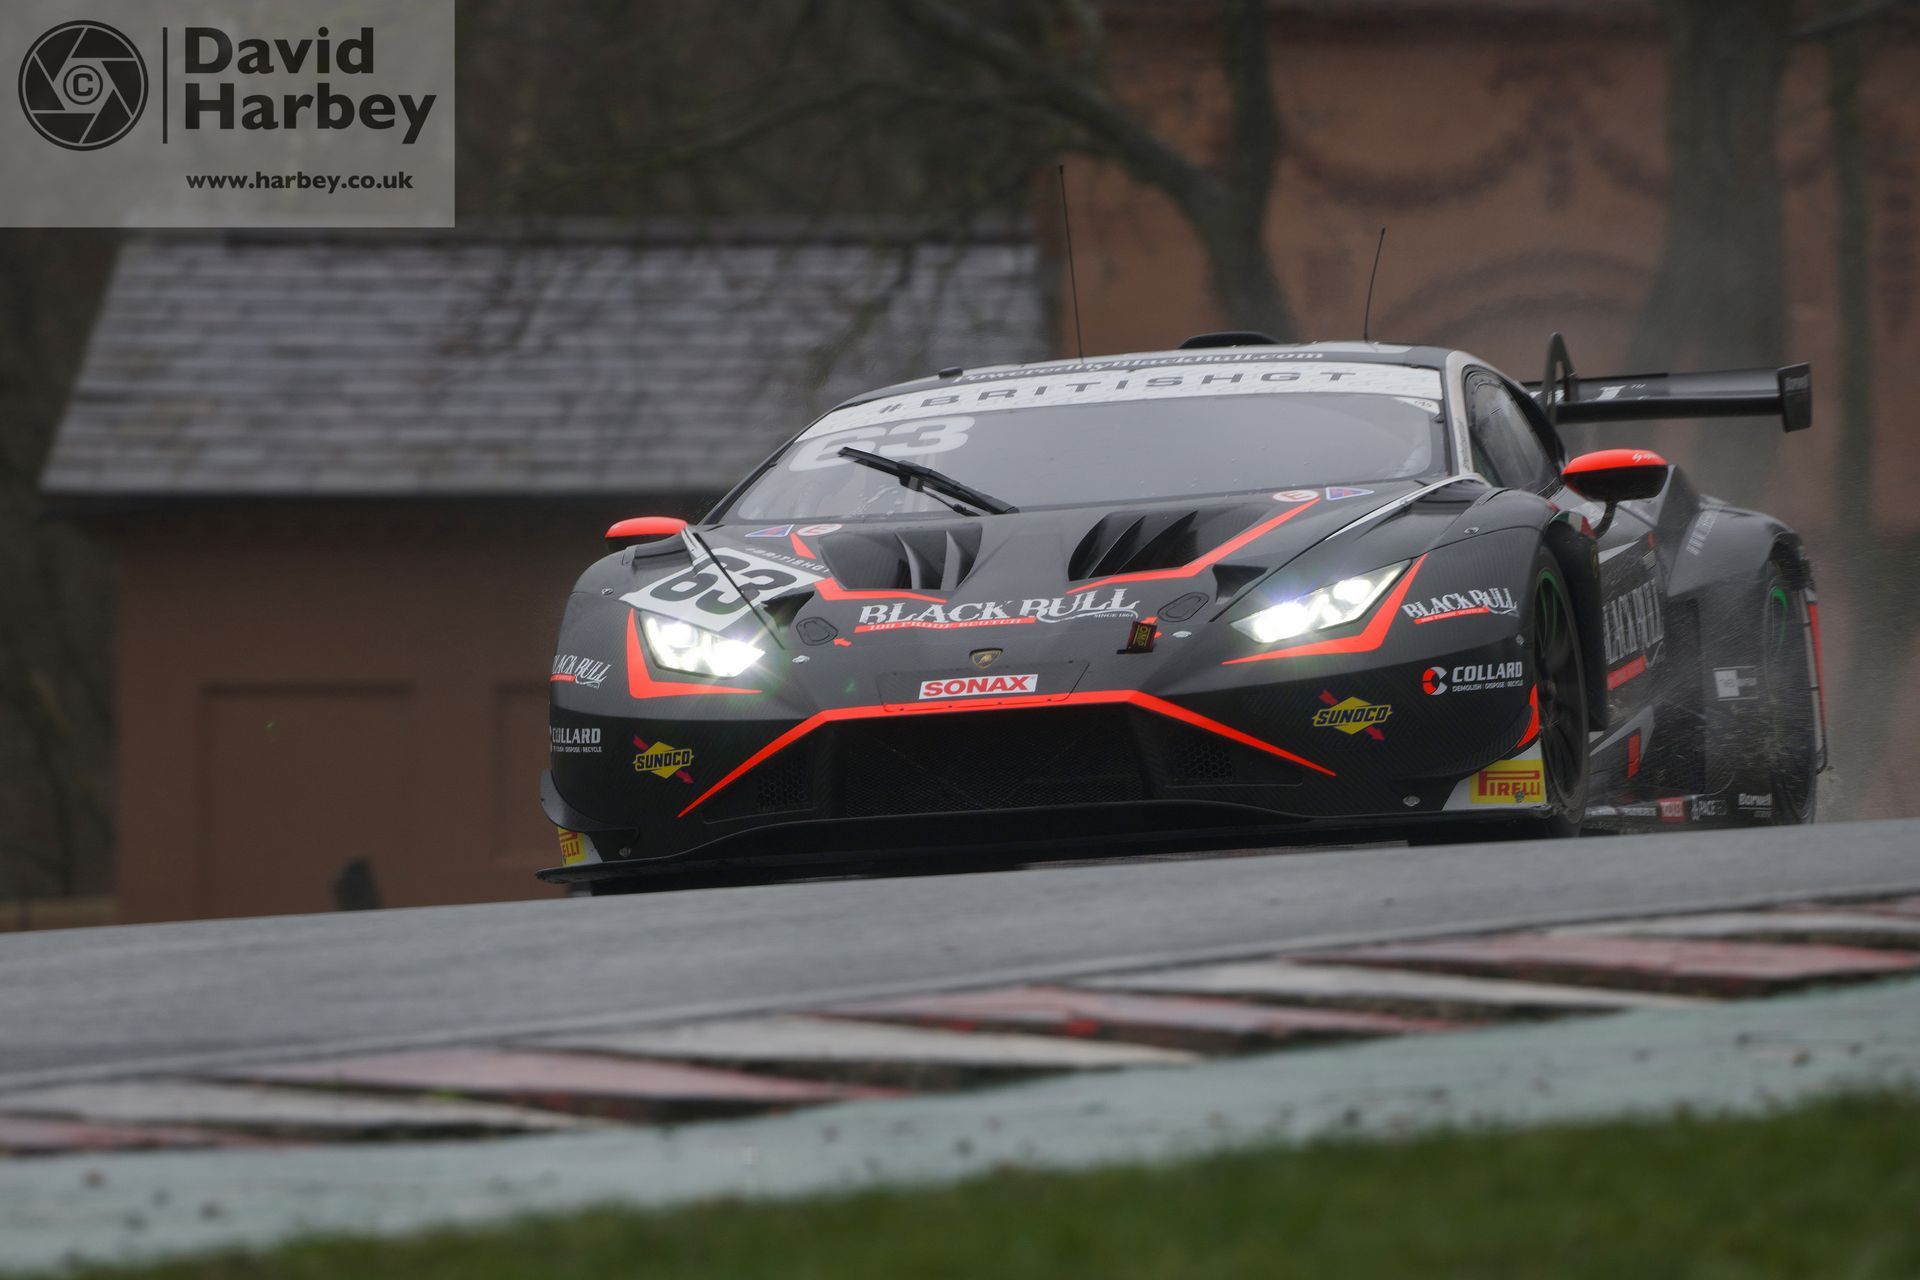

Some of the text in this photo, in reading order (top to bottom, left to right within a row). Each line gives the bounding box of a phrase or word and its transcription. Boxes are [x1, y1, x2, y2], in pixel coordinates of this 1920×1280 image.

[788, 416, 976, 472] 63
[650, 555, 798, 615] 63
[859, 588, 1141, 624] BLACK BULL
[1402, 587, 1518, 618] BLACK BULL
[574, 657, 612, 683] BULL
[1452, 661, 1523, 683] COLLARD
[923, 676, 1031, 697] SONAX
[1316, 705, 1390, 726] SUNOCO
[636, 750, 691, 770] SUNOCO
[1477, 770, 1540, 797] PIRELLI
